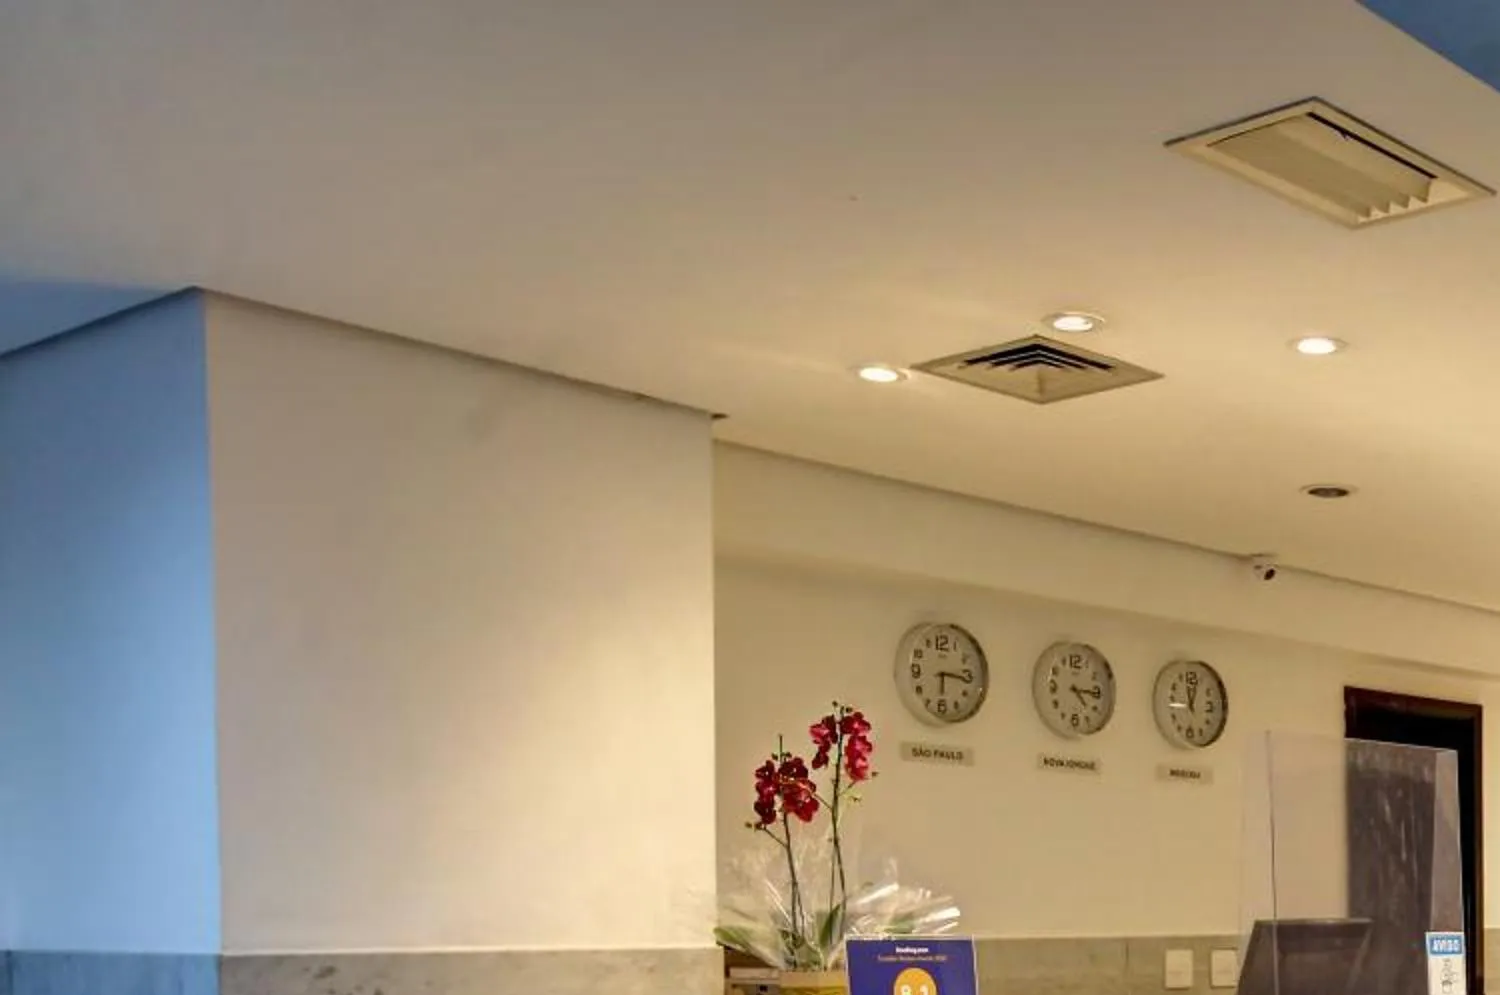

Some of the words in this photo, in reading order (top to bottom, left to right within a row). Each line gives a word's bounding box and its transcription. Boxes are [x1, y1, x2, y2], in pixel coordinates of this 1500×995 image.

[935, 634, 949, 652] 12
[1069, 654, 1082, 669] 12
[911, 663, 920, 679] 9
[962, 668, 974, 684] 3
[1186, 671, 1198, 686] 12
[937, 698, 947, 715] 6
[1071, 713, 1079, 727] 6
[911, 744, 932, 758] SÃO
[933, 749, 964, 761] PAULO
